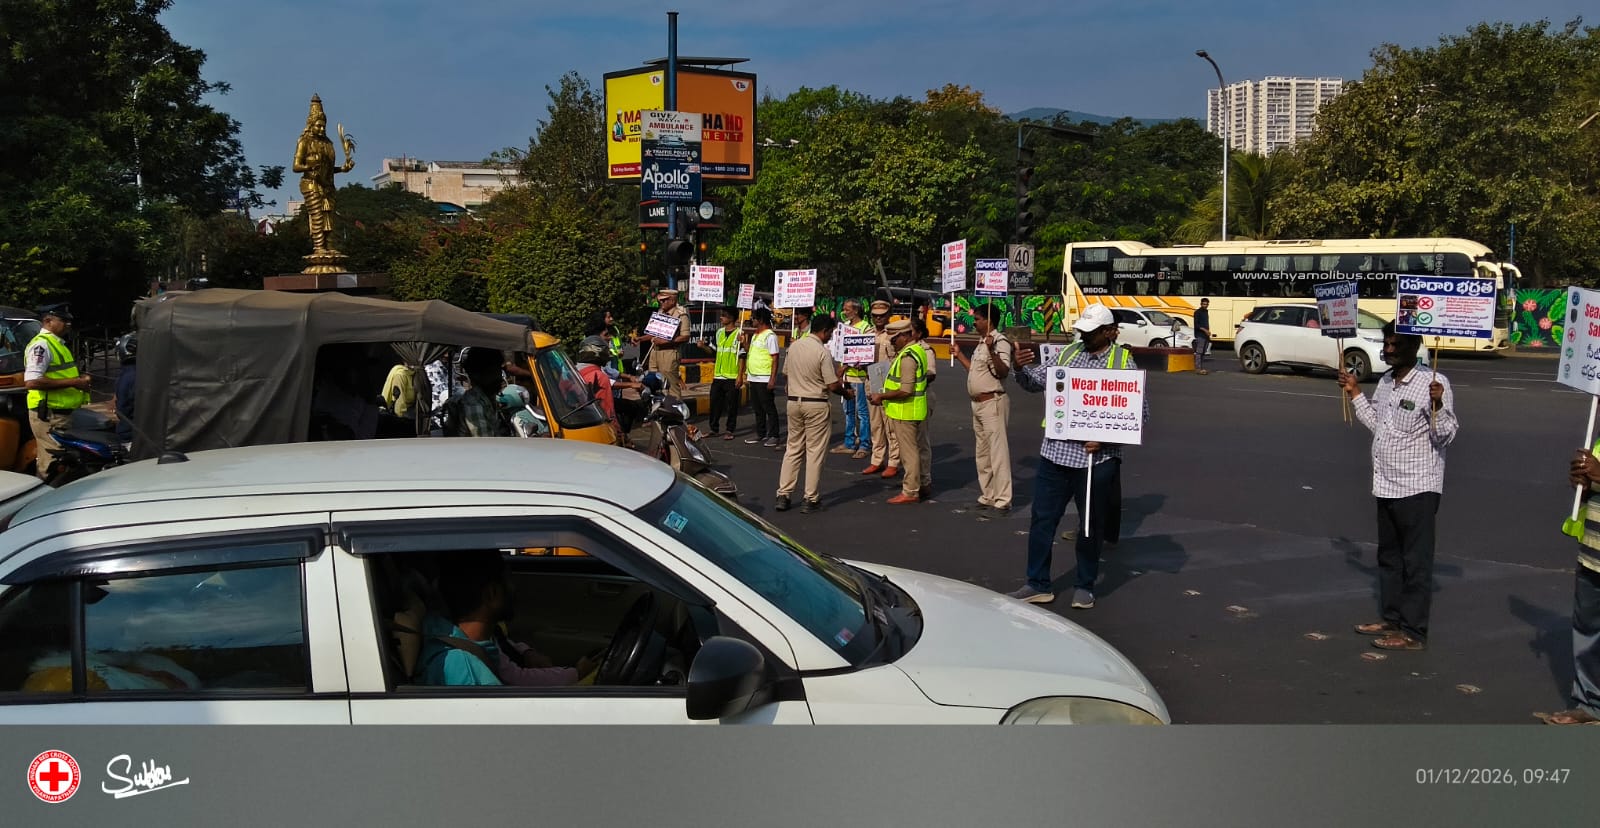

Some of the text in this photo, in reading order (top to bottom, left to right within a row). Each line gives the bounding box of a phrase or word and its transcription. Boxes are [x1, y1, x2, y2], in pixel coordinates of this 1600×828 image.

[624, 110, 641, 123] MA
[702, 113, 723, 130] HA
[649, 122, 694, 130] AMBULANCE
[702, 131, 740, 141] MENT
[643, 168, 690, 190] Apollo
[649, 206, 665, 217] LANE
[1014, 249, 1030, 267] 40
[1010, 274, 1030, 287] Apollo
[1232, 270, 1398, 282] www.shyamolibus.com
[1400, 277, 1493, 297] రహదారి భద్రత
[1584, 303, 1600, 320] Sea
[1071, 377, 1141, 394] Wear Helmet,
[1082, 393, 1128, 408] Save life
